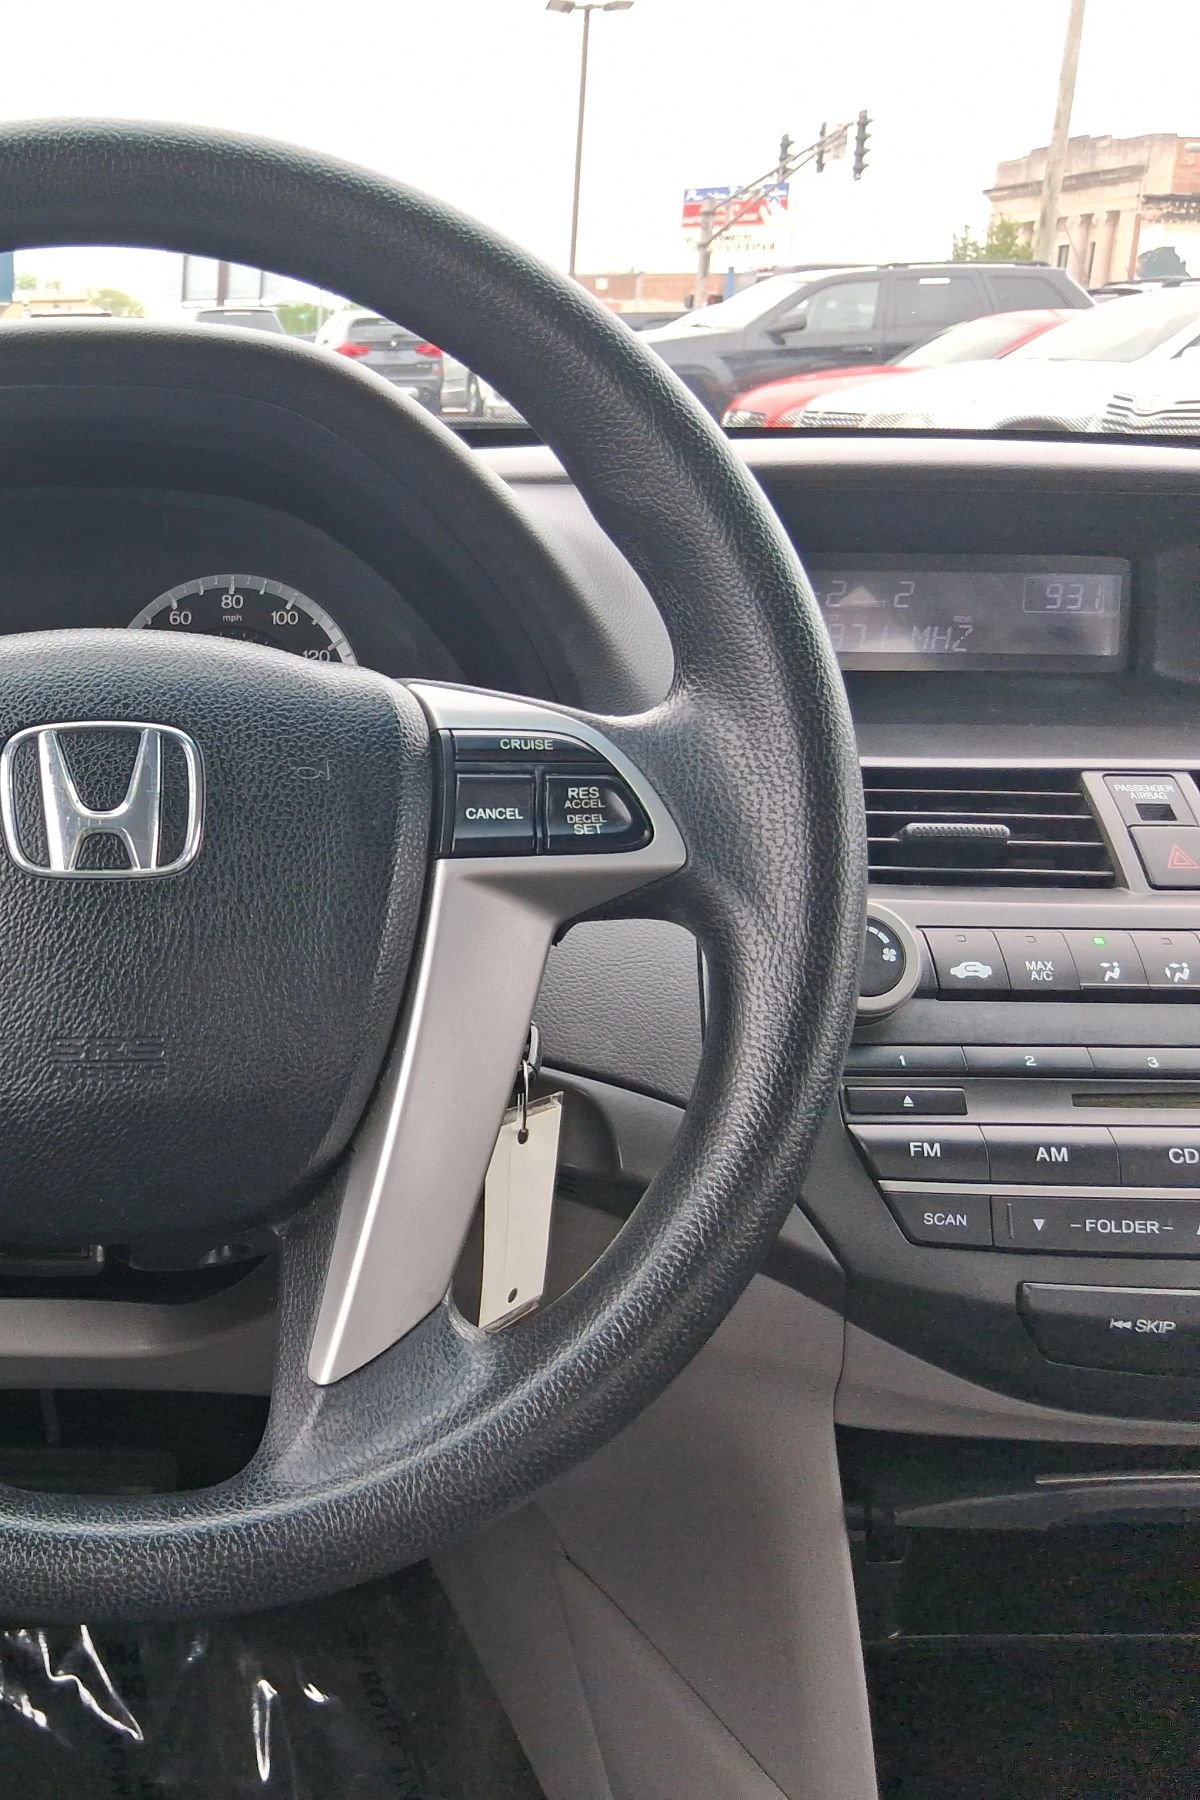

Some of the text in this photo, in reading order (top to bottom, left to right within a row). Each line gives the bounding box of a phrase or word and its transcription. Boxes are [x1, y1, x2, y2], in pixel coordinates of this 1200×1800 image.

[221, 596, 243, 609] 80
[169, 611, 192, 625] 60
[222, 614, 243, 623] mph
[270, 611, 298, 625] 100
[303, 649, 330, 662] 120
[500, 738, 553, 750] CRUISE
[567, 787, 600, 799] RES
[1113, 784, 1175, 793] PASSENGER
[1130, 791, 1168, 800] AIRBAG
[564, 800, 606, 809] ACCEL
[465, 808, 523, 820] CANCEL
[567, 814, 607, 824] DECEL
[573, 823, 603, 835] SET
[1025, 961, 1054, 971] MAX
[1030, 970, 1053, 981] A/C
[900, 1055, 907, 1066] 1
[1024, 1055, 1037, 1066] 2
[1147, 1056, 1160, 1068] 3
[909, 1142, 941, 1157] FM
[1036, 1147, 1069, 1162] AM
[1168, 1148, 1199, 1164] CD
[923, 1212, 967, 1226] SCAN
[1135, 1319, 1176, 1333] SKIP
